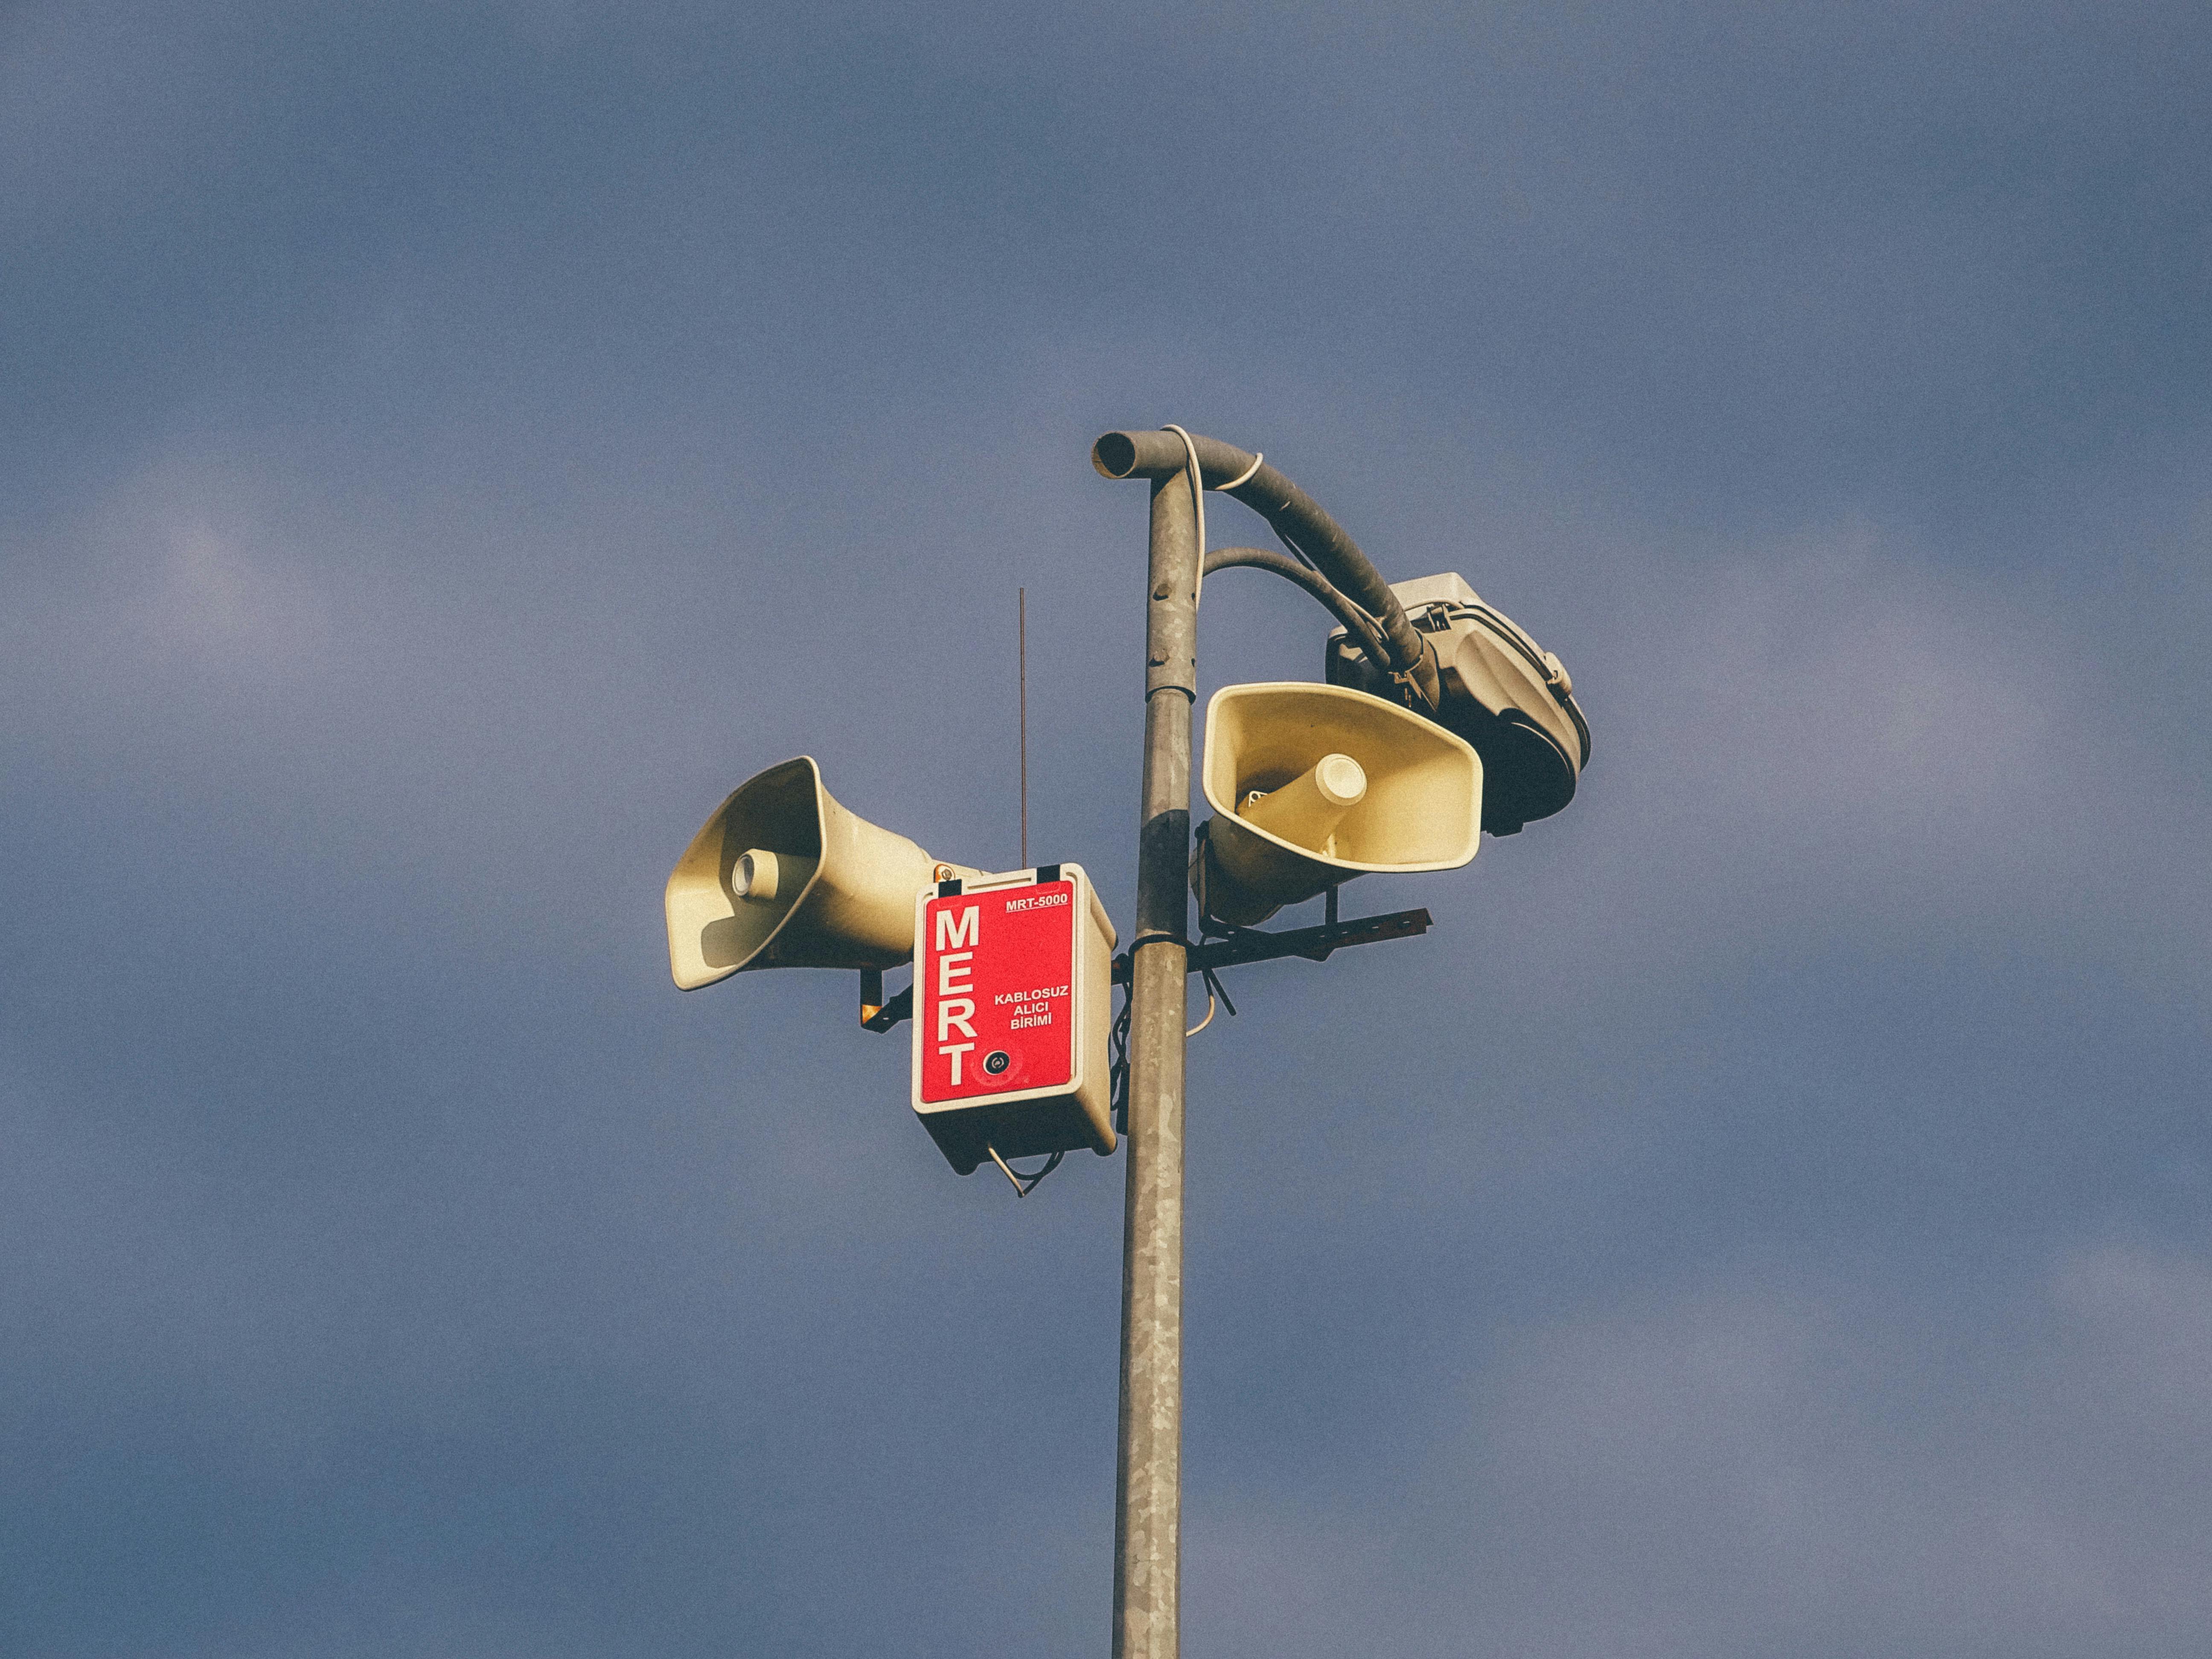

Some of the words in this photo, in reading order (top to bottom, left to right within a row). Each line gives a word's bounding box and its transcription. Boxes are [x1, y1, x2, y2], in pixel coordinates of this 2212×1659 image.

[1006, 893, 1068, 911] MRT-5000
[936, 905, 979, 1086] MERT
[995, 985, 1068, 1005] KABLOSUZ
[1014, 1001, 1048, 1016] ALICI
[1010, 1012, 1051, 1030] BİRİMİ
